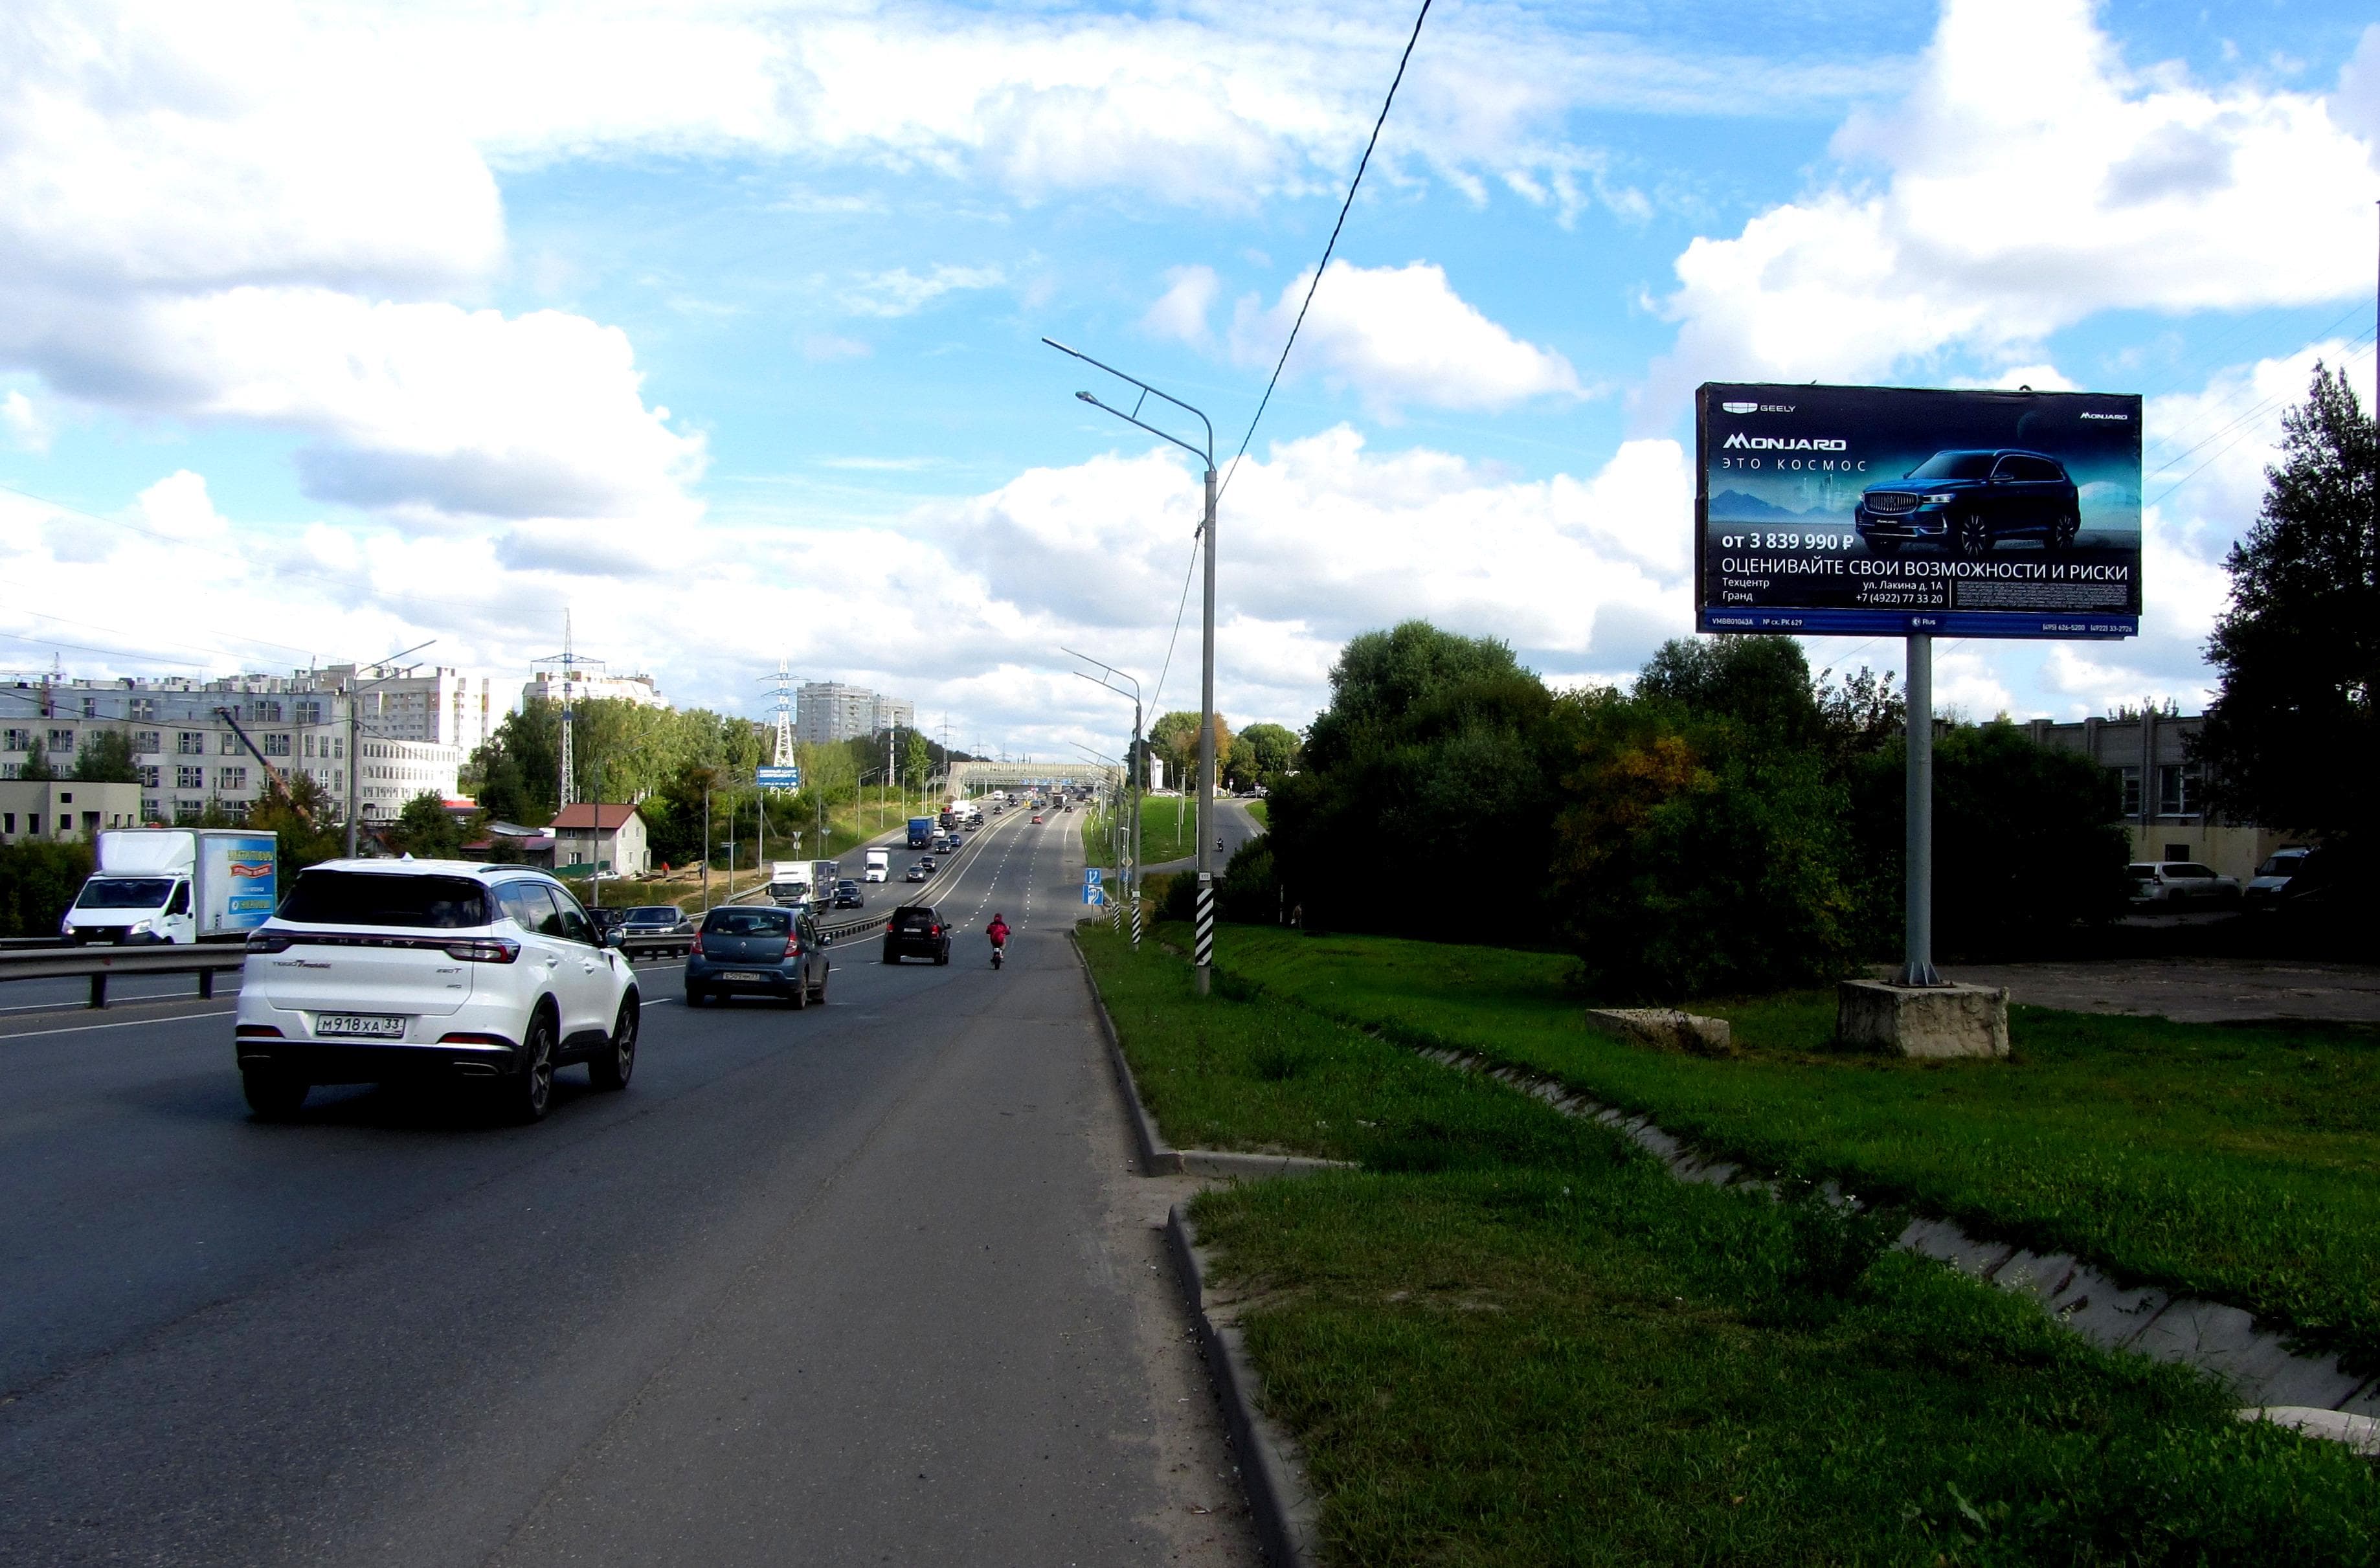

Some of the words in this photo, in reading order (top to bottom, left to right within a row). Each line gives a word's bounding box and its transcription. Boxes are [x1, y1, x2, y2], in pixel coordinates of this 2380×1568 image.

[2080, 412, 2128, 420] MONJARO
[1723, 432, 1847, 451] MONJARO
[1722, 458, 1760, 469] ЭТО
[1777, 459, 1865, 471] КОСМОС
[1722, 535, 1745, 548] от
[1750, 532, 1760, 548] 3
[1766, 533, 1799, 549] 839
[1804, 533, 1838, 550] 990
[1722, 555, 1843, 576] ОЦЕНИВАЙТЕ
[1849, 560, 1898, 576] СВОИ
[1905, 561, 2046, 578] ВОЗМОЖНОСТИ
[2052, 565, 2064, 579] И
[2070, 565, 2127, 580] РИСКИ
[1722, 577, 1770, 589] Техцентр
[1863, 581, 1878, 591] ул.
[1879, 580, 1916, 590] Лакина
[1918, 583, 1927, 592] д.
[1722, 590, 1753, 602] Гранд
[1856, 593, 1868, 602] +7
[1870, 593, 1900, 604] (4922)
[1902, 594, 1914, 603] 77
[1916, 594, 1929, 603] 33
[1931, 594, 1943, 603] 20
[318, 937, 414, 946] CHERY
[385, 1018, 399, 1029] 33
